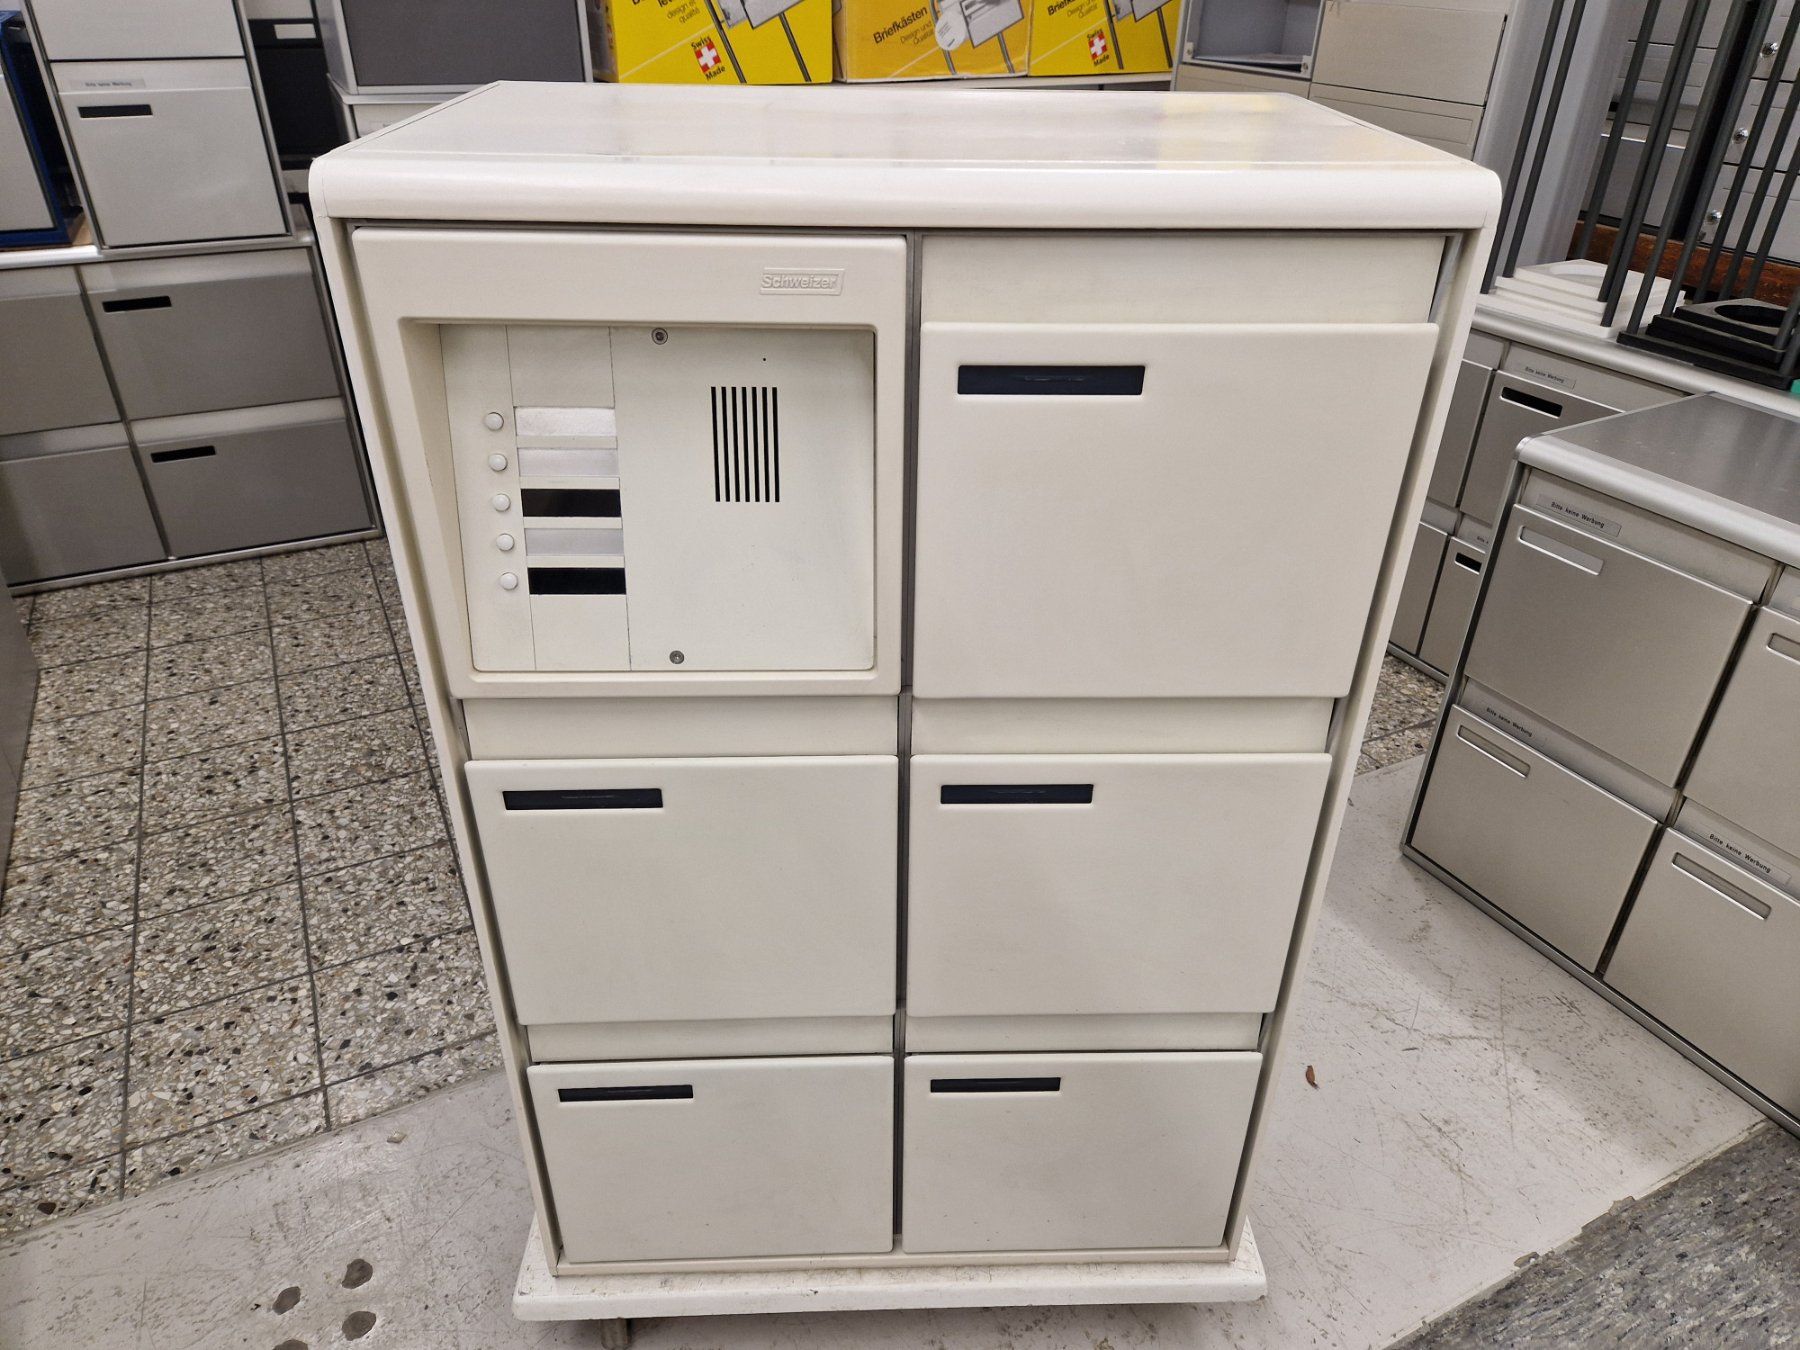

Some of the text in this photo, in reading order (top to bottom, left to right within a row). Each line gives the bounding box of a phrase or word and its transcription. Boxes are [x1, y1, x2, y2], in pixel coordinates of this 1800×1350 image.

[873, 6, 928, 44] Briefkästen
[691, 36, 712, 49] Swiss
[705, 66, 726, 81] Made
[761, 273, 836, 290] Schweizer
[1551, 501, 1605, 529] Bitte keine Werbung
[1486, 707, 1497, 717] Bitte
[1512, 721, 1533, 738] Werbung
[1709, 833, 1772, 874] Bitte keine Werbung
